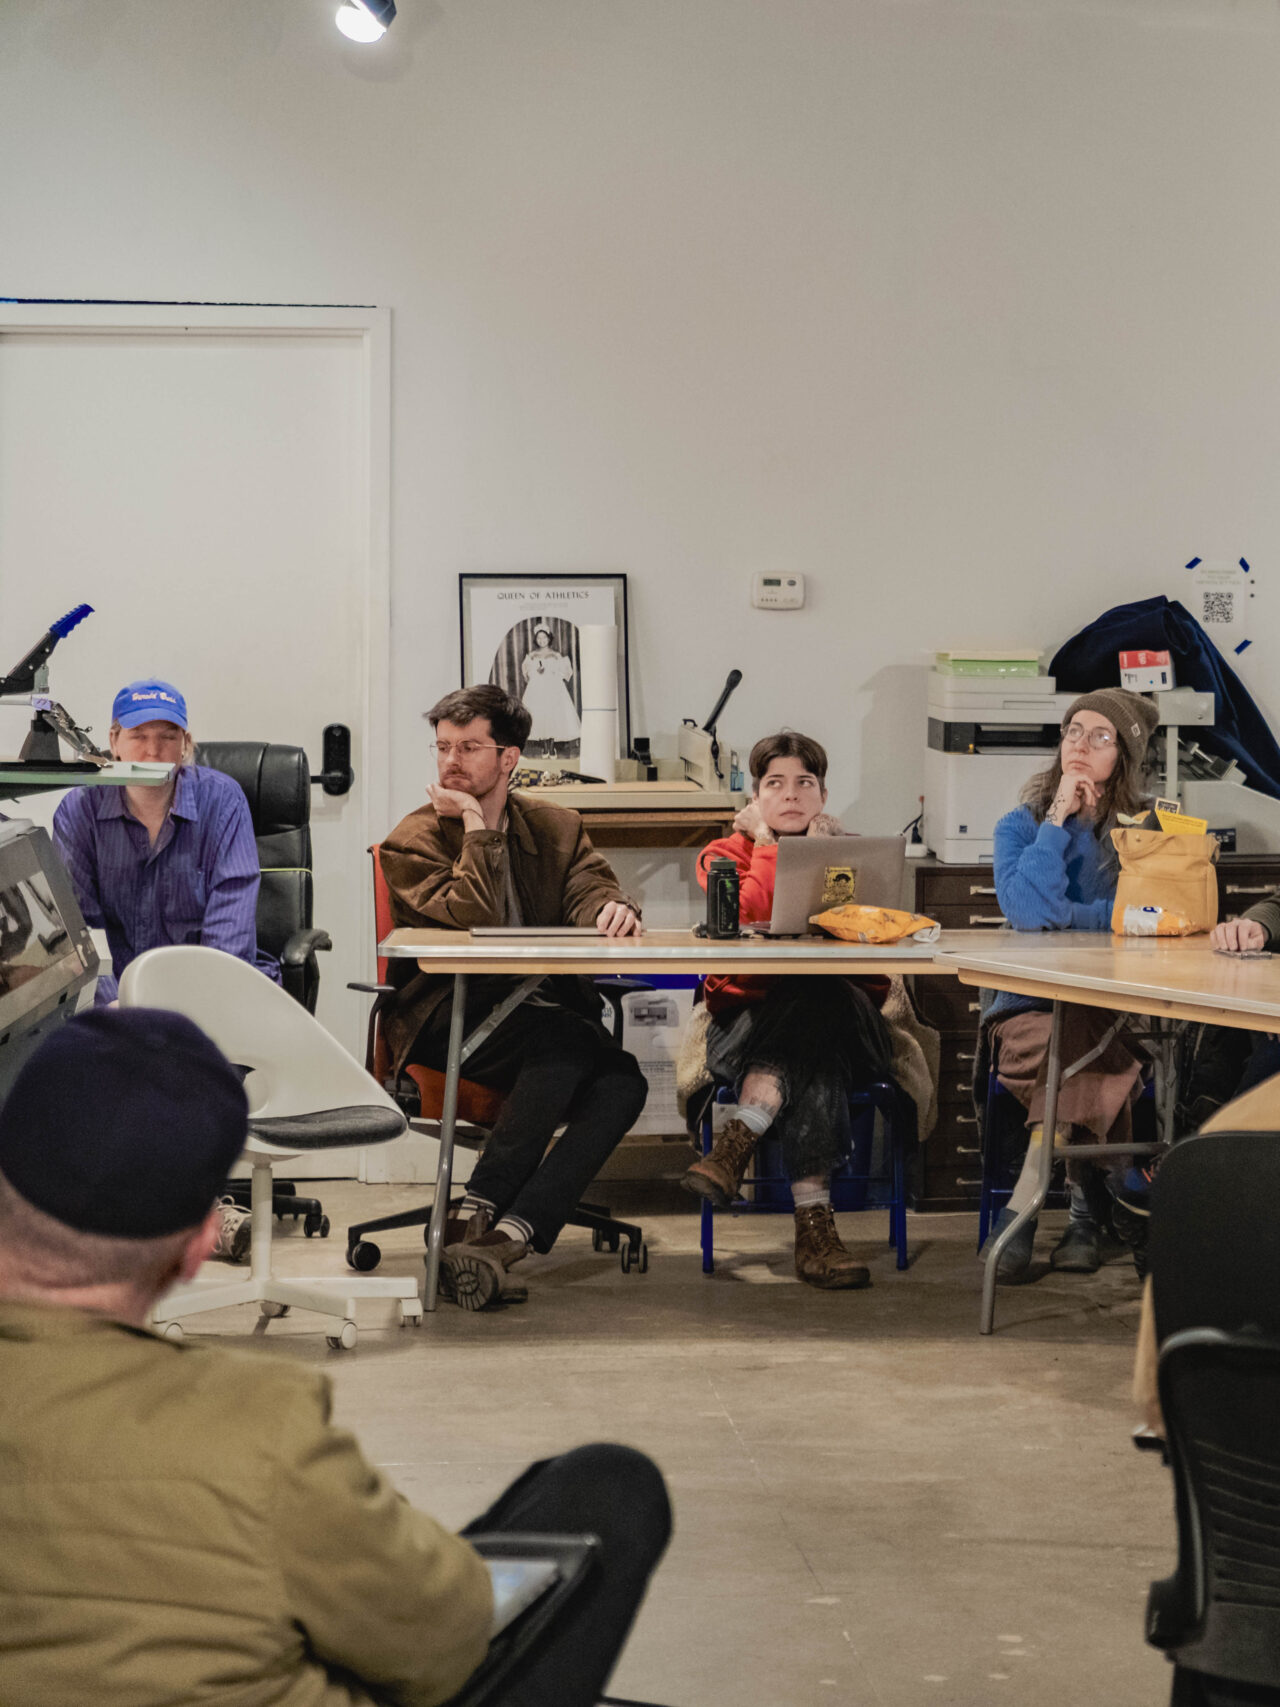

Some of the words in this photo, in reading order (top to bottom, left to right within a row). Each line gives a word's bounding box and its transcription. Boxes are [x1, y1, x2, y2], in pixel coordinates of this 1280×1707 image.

[497, 592, 525, 600] QUEEN
[529, 592, 540, 600] OF
[545, 591, 590, 600] ATHLETICS
